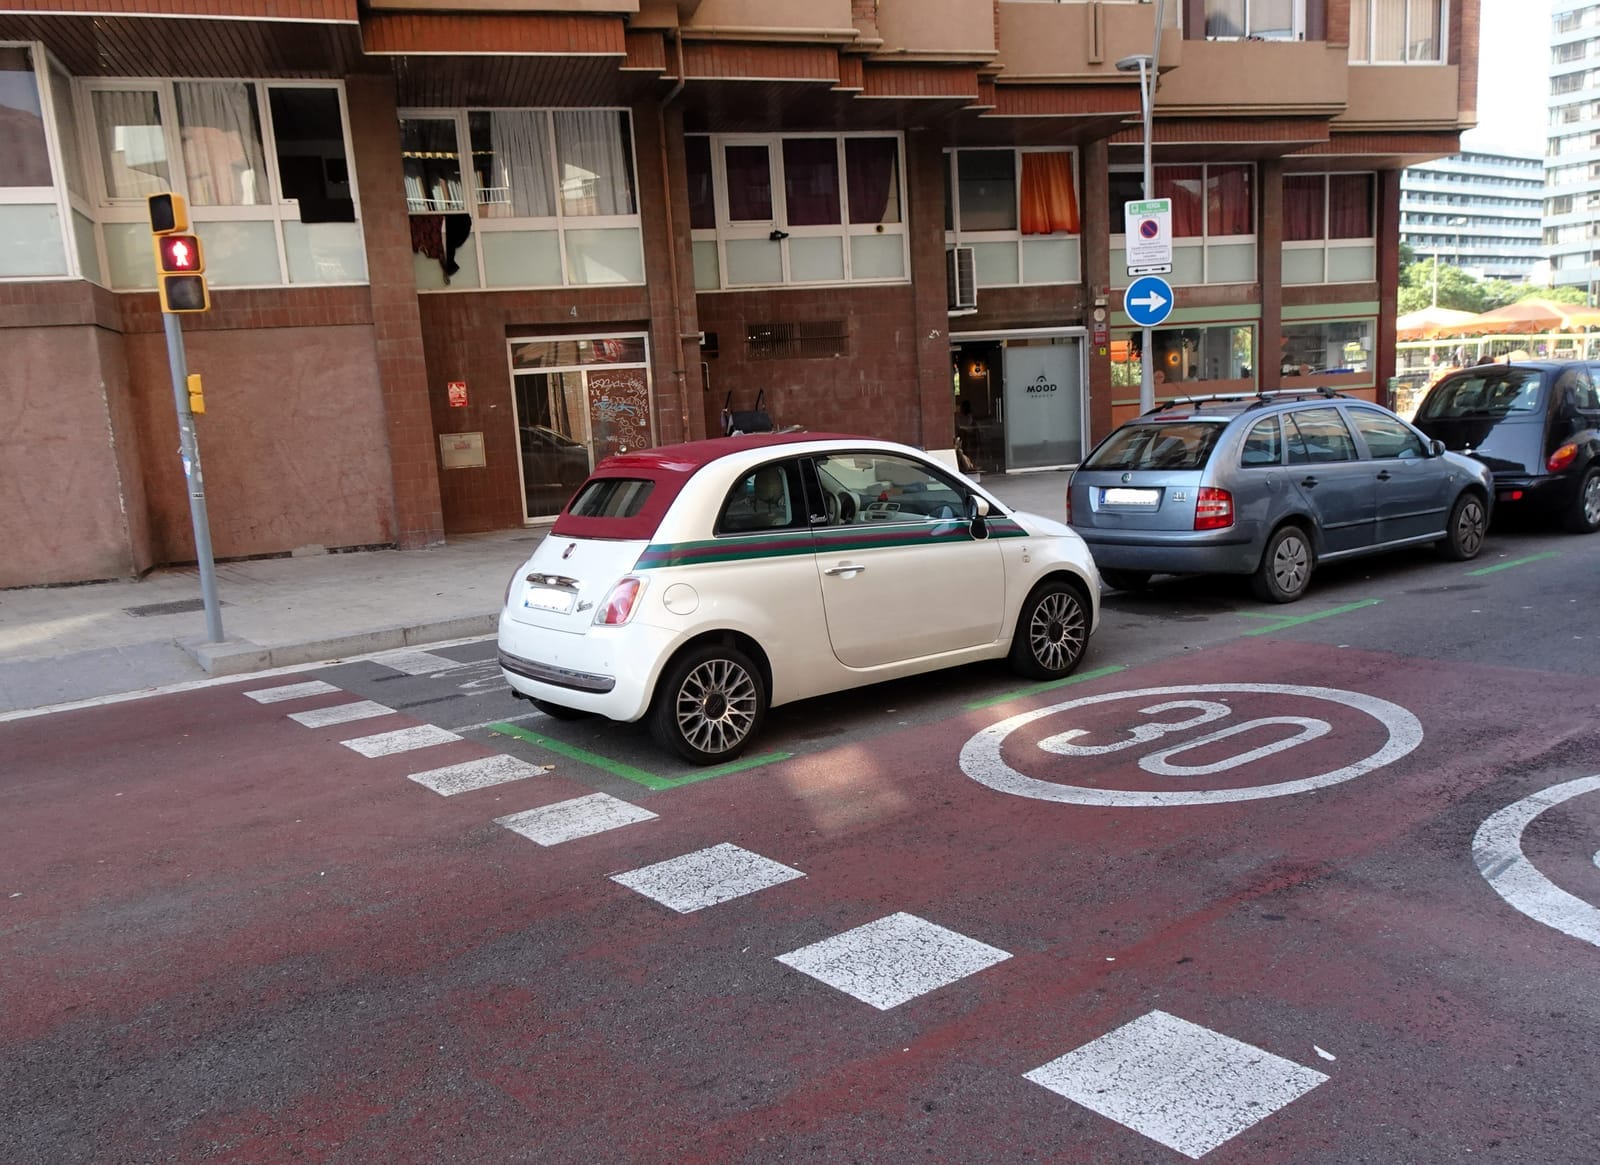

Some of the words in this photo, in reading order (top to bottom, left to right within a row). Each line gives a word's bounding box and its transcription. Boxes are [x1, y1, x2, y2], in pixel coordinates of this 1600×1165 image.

[570, 305, 577, 317] 4
[1026, 383, 1057, 393] MOOD
[1037, 699, 1333, 777] 30
